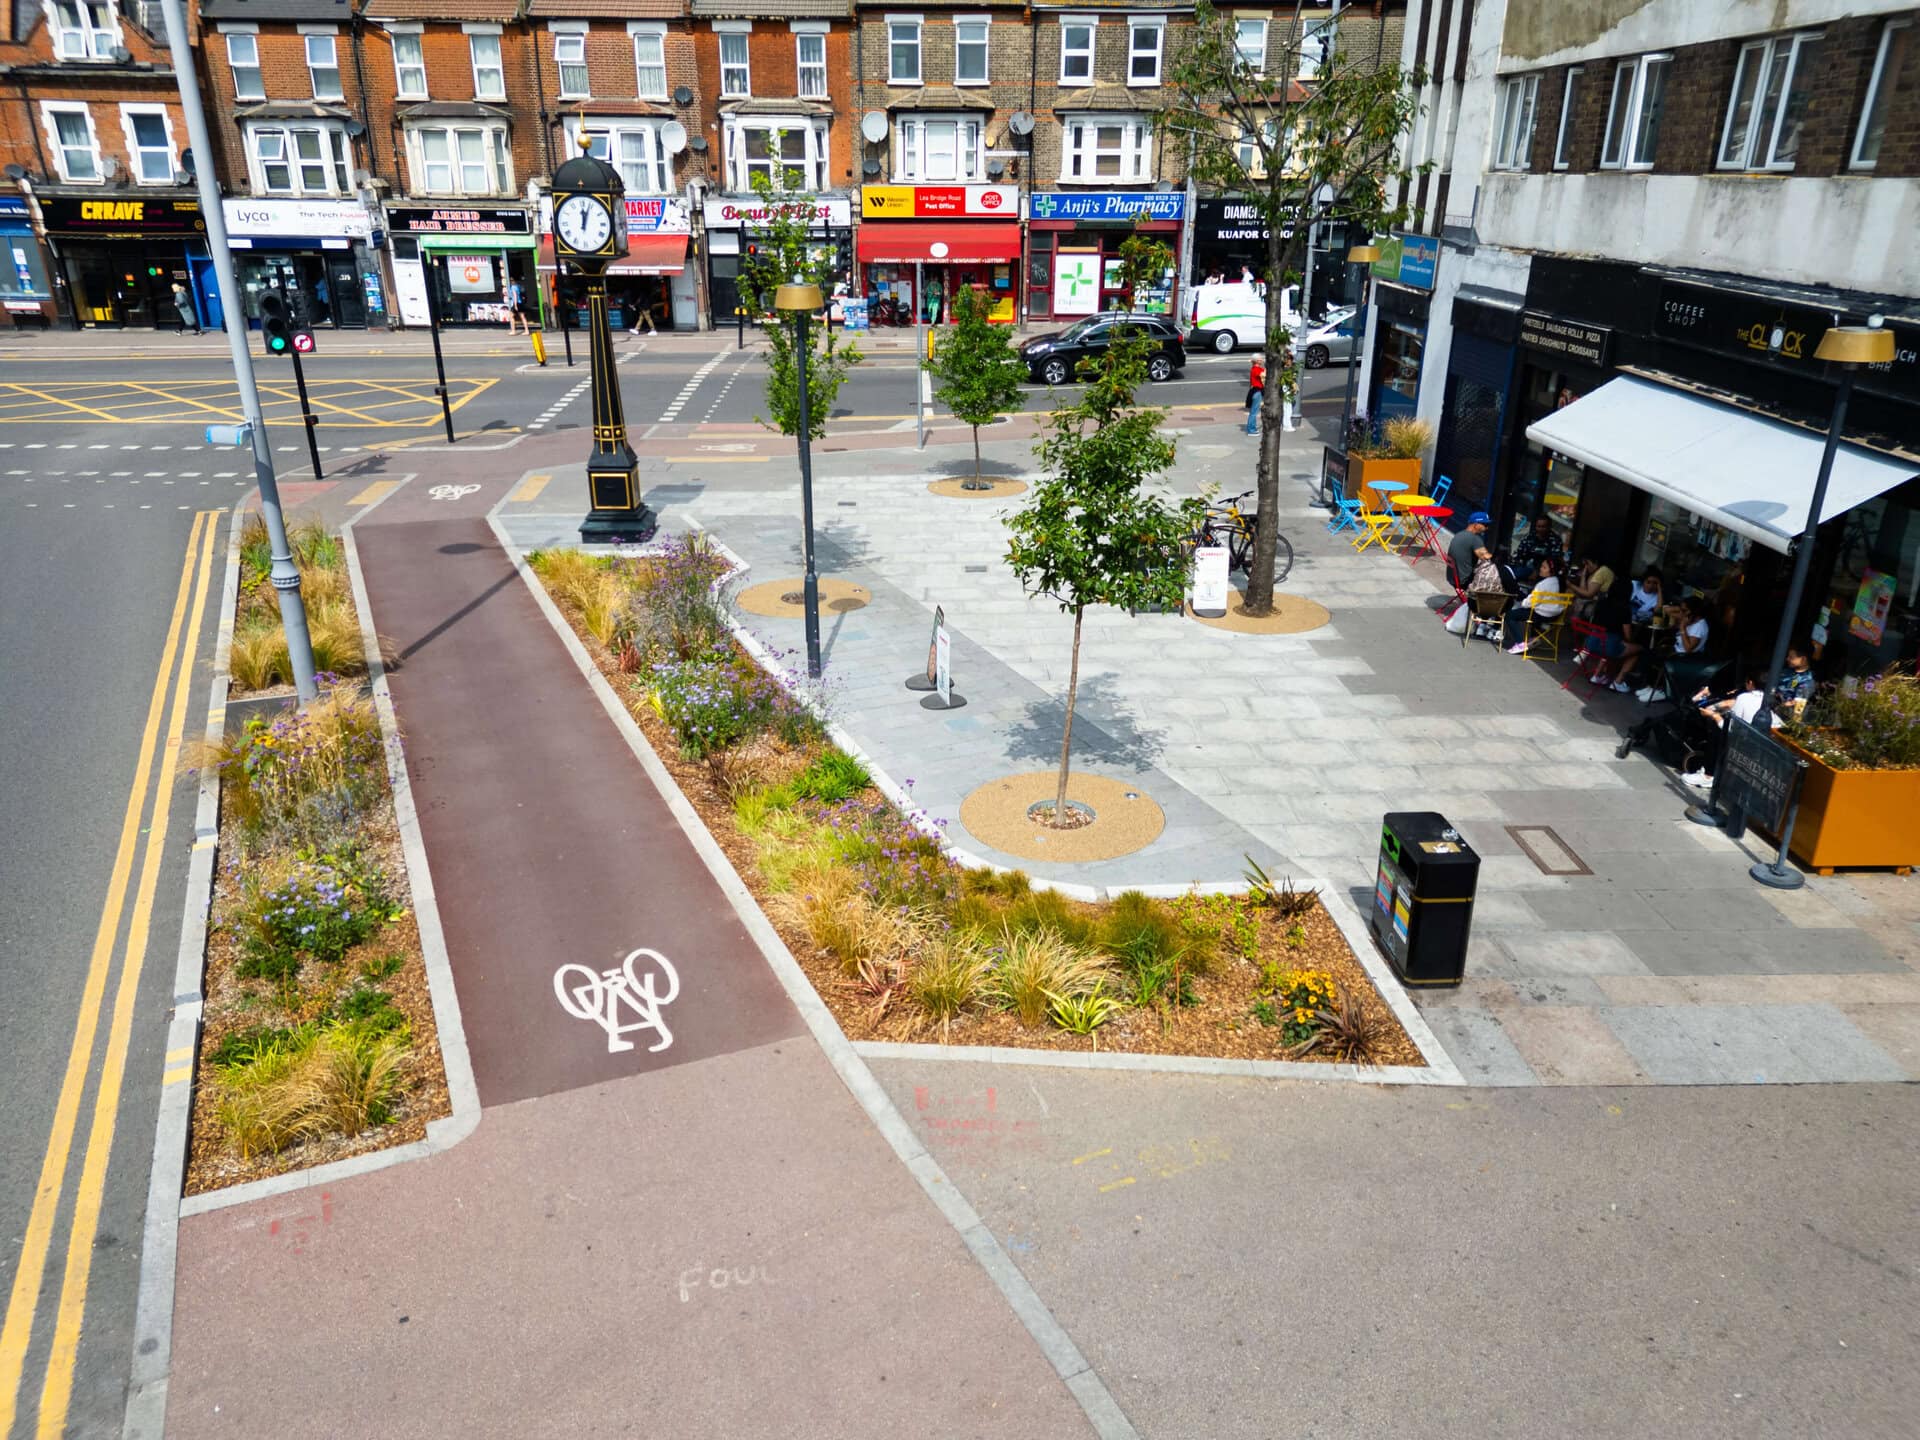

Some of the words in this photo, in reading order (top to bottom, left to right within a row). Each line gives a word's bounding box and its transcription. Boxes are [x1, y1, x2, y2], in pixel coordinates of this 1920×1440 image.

[81, 201, 145, 221] CRRAVE
[1060, 199, 1101, 217] Anji's
[1103, 196, 1182, 218] Pharmacy
[237, 209, 270, 224] Lyca
[431, 210, 481, 221] AHMED
[409, 220, 442, 231] HAIR
[445, 221, 506, 231] DRESSER
[1217, 230, 1259, 239] KUAFOR
[1664, 300, 1705, 318] COFFEE
[1667, 312, 1696, 326] SHOP
[1567, 327, 1584, 339] ROLLS
[1736, 328, 1749, 341] THE
